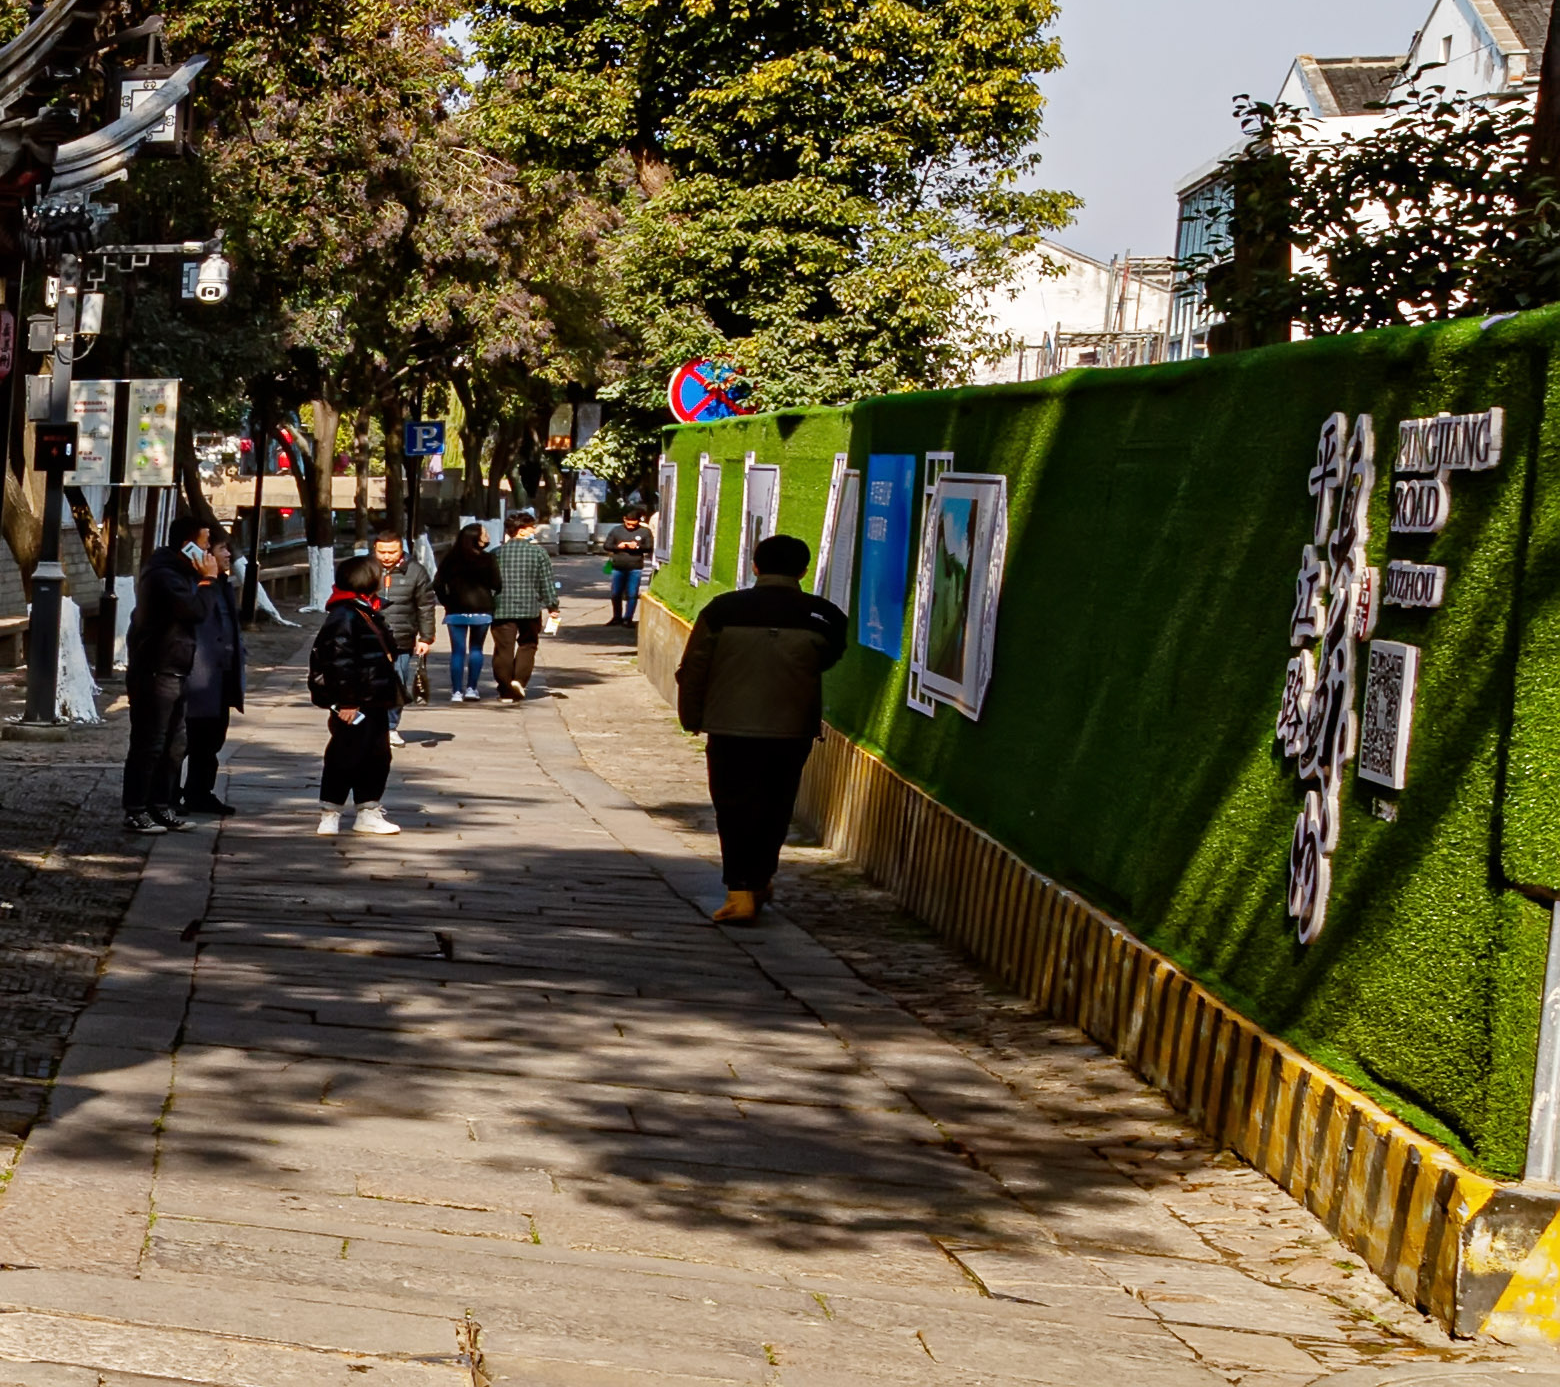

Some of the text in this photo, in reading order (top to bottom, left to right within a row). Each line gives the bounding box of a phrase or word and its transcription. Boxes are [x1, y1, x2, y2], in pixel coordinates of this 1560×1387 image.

[413, 426, 437, 452] P
[1396, 417, 1491, 476] PINGJIANG
[1392, 486, 1440, 527] ROAD
[1277, 423, 1338, 749] 平江路
[1385, 567, 1436, 602] SUZHOU
